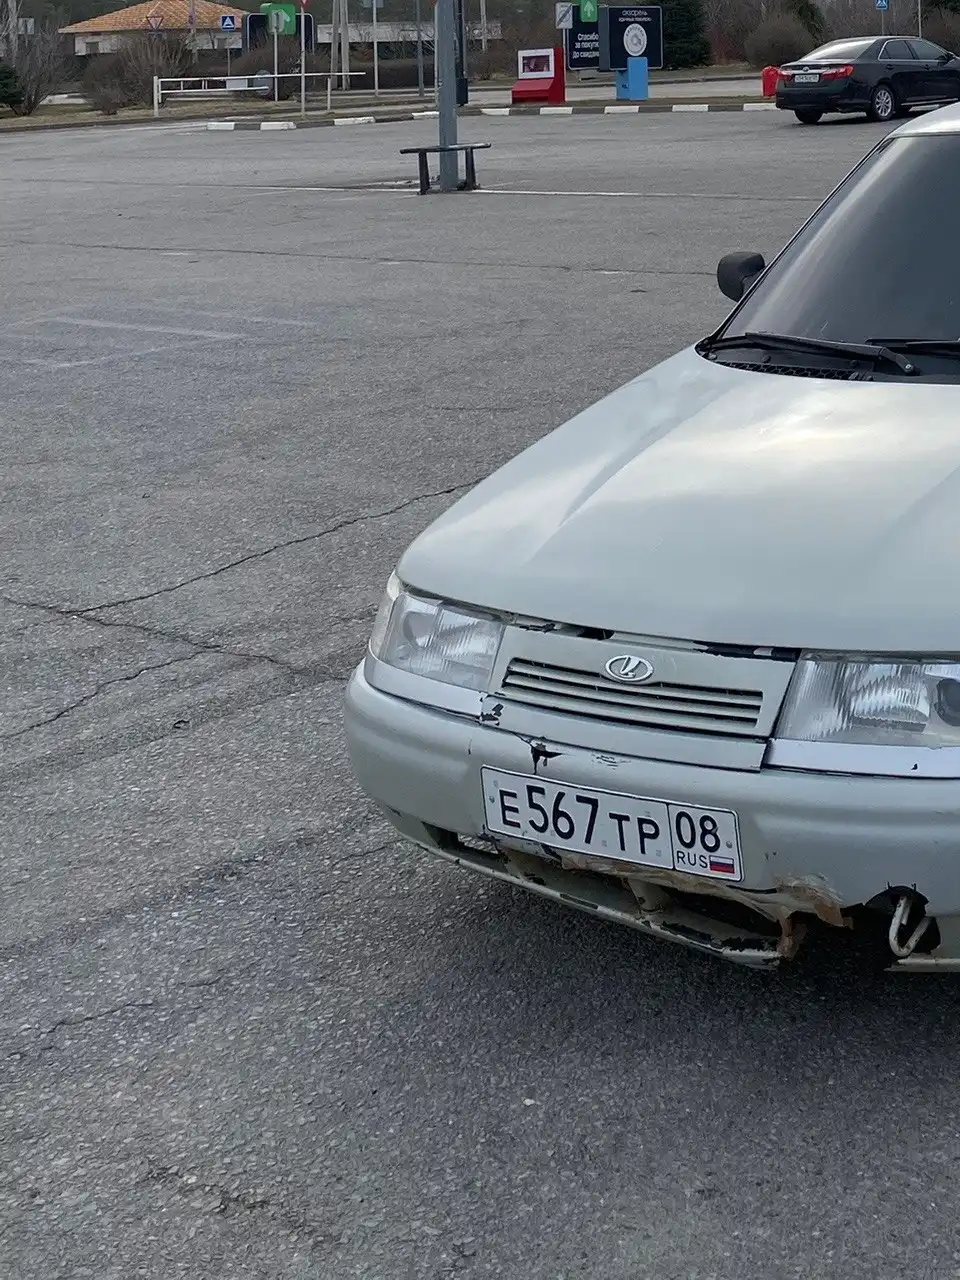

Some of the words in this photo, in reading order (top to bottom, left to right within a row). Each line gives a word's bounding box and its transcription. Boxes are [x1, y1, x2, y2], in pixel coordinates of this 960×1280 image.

[581, 41, 600, 50] покупк
[674, 810, 721, 853] 08
[676, 850, 708, 869] RUS
